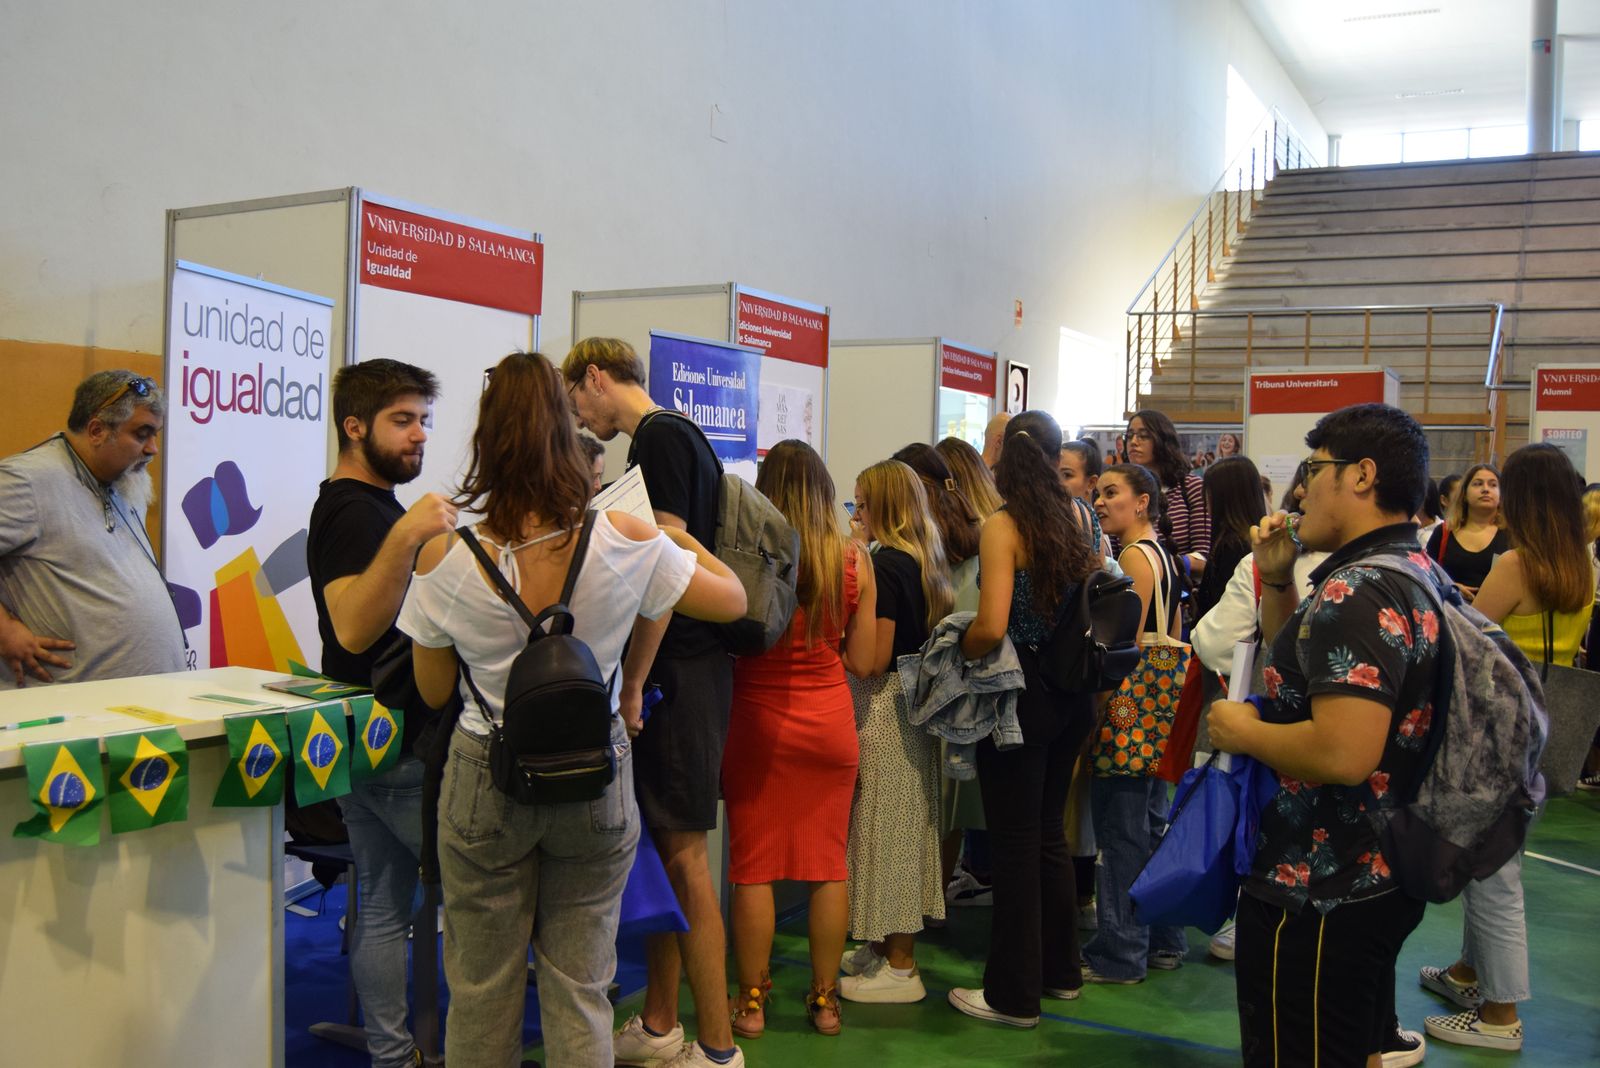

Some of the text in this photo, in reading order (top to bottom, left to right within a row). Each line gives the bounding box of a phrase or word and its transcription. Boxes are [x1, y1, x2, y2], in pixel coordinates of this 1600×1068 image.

[367, 240, 418, 263] Unidad de
[468, 236, 536, 265] SALAMANCA
[366, 258, 412, 280] Igualdad
[183, 298, 325, 360] unidad de
[738, 320, 792, 340] diciones Universidad
[788, 312, 824, 332] SALAMANCA
[743, 334, 772, 348] Salamanca
[182, 349, 323, 425] igualdad
[672, 362, 746, 390] Ediciones Universidad
[1255, 379, 1338, 389] Tribuna Universitaria
[1542, 388, 1572, 396] Alumni
[673, 387, 746, 430] Salamanca
[1546, 430, 1583, 440] SORTEO
